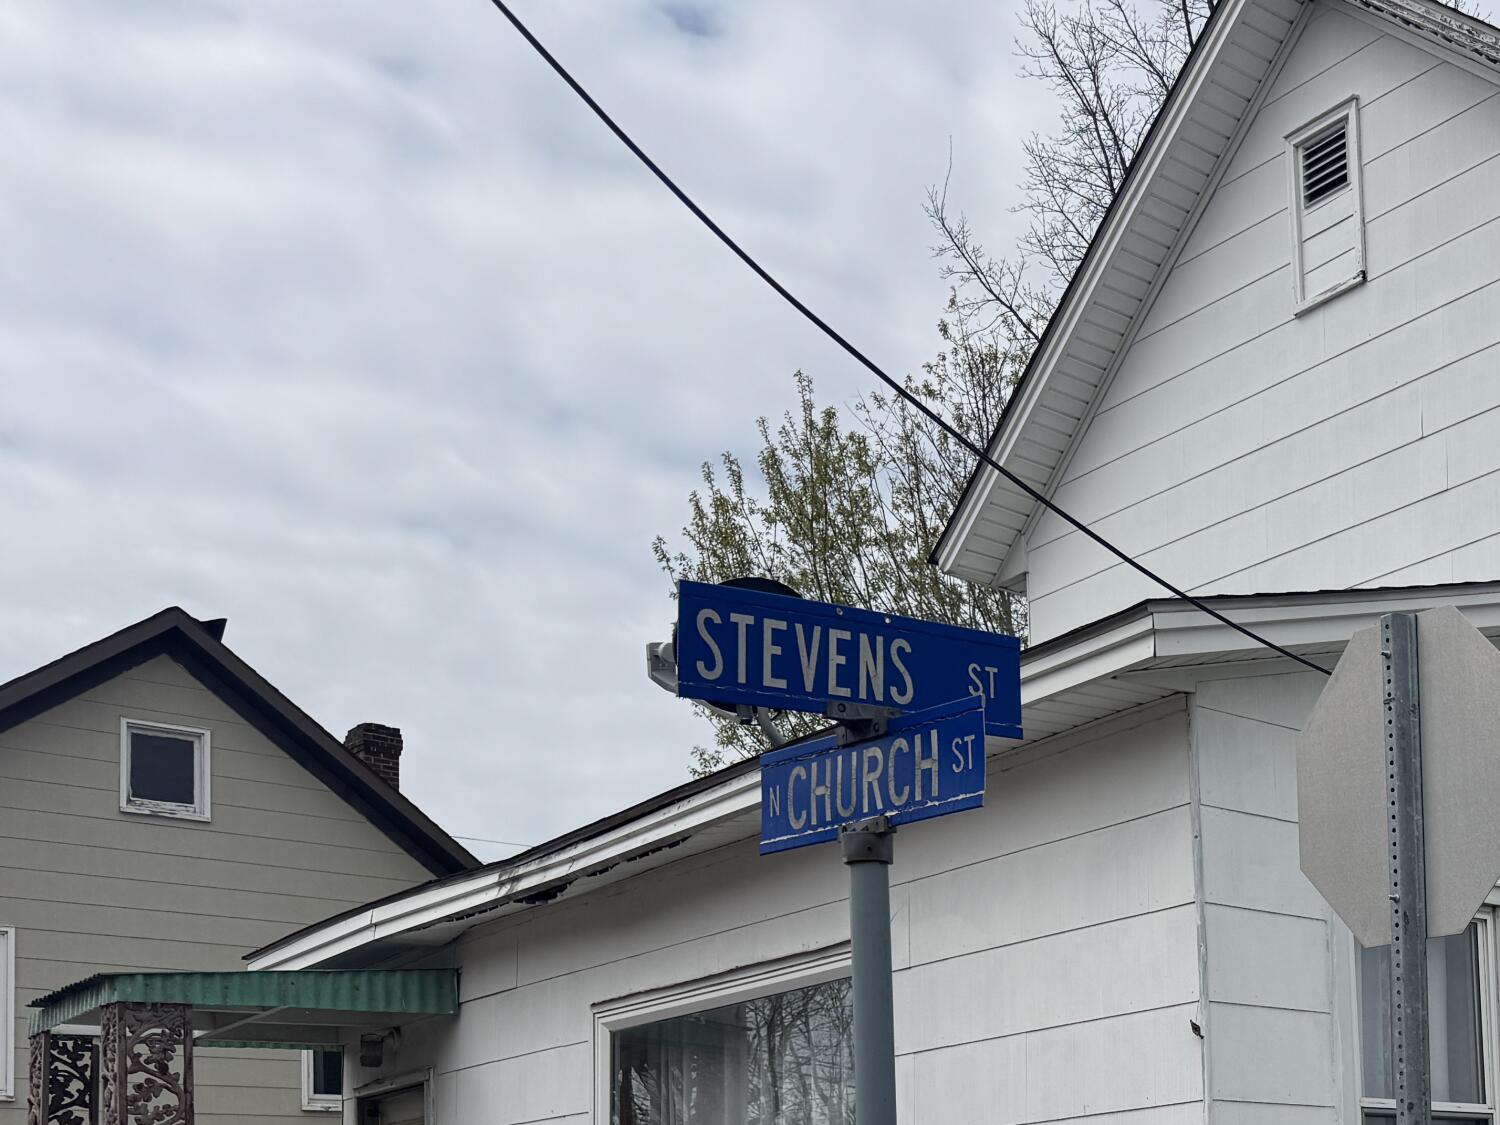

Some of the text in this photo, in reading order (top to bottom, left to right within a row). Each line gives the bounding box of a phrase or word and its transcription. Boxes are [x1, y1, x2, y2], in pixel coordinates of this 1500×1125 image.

[696, 608, 998, 705] STEVENS ST
[769, 729, 975, 830] N CHURCH ST
